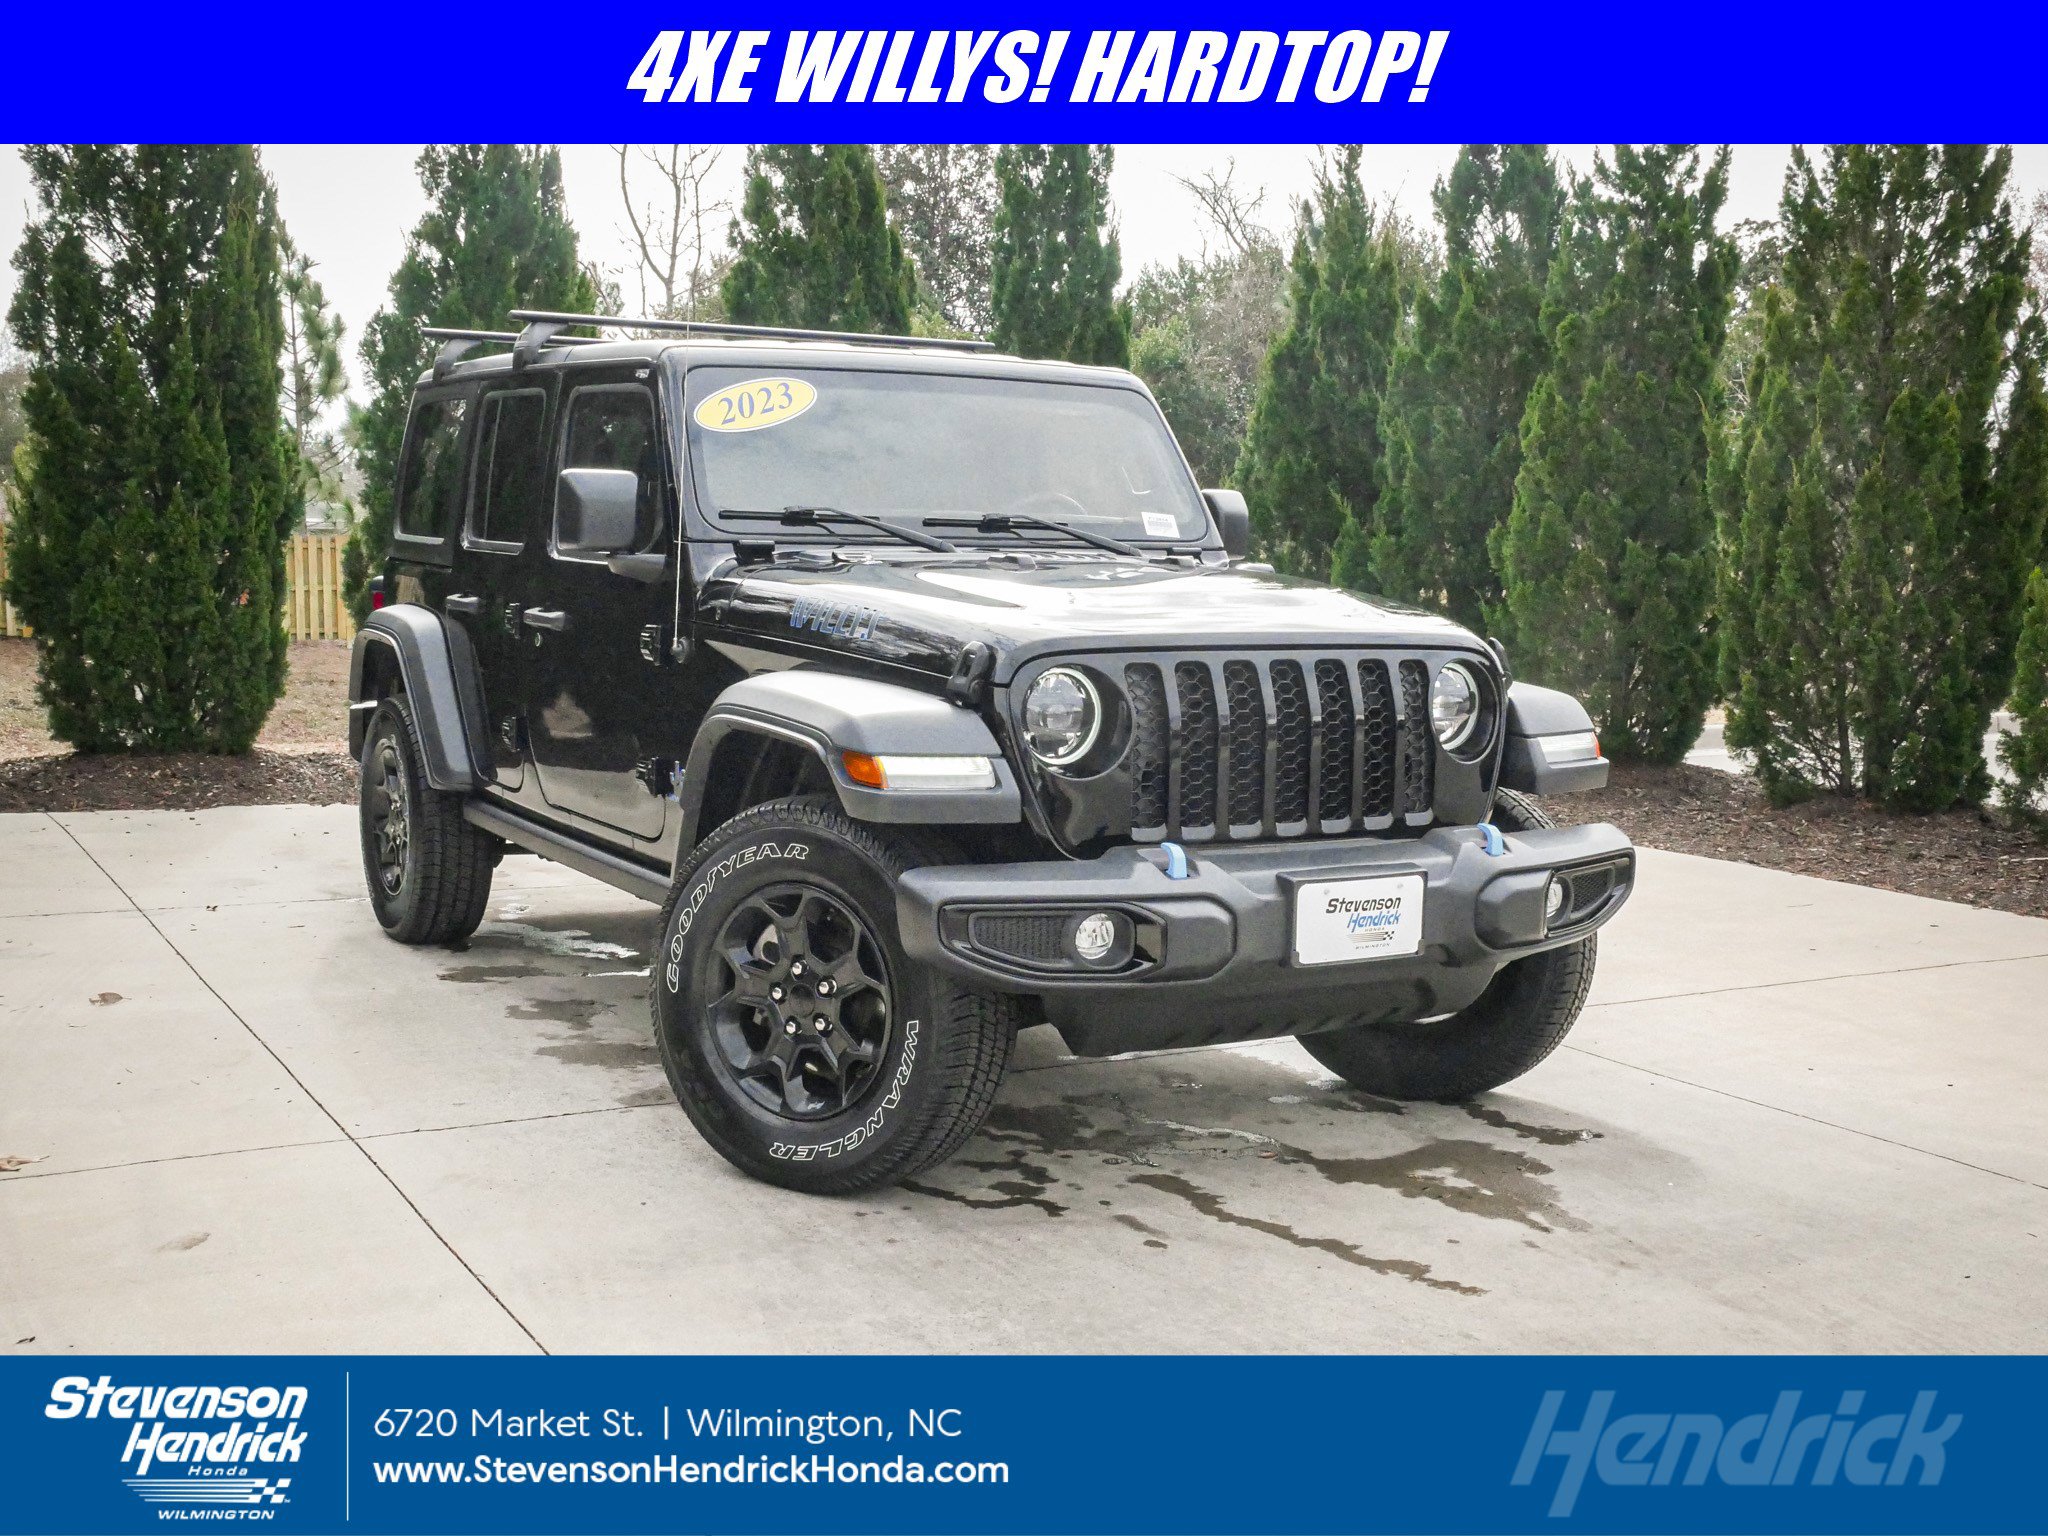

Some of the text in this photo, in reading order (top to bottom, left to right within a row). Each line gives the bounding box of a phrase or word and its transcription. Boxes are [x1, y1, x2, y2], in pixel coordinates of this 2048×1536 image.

[718, 382, 793, 425] 2023
[667, 842, 810, 993] GOODYEAR
[1326, 897, 1401, 913] Stevenson
[1347, 910, 1401, 933] Hendrick
[769, 1019, 919, 1161] WRANGLER
